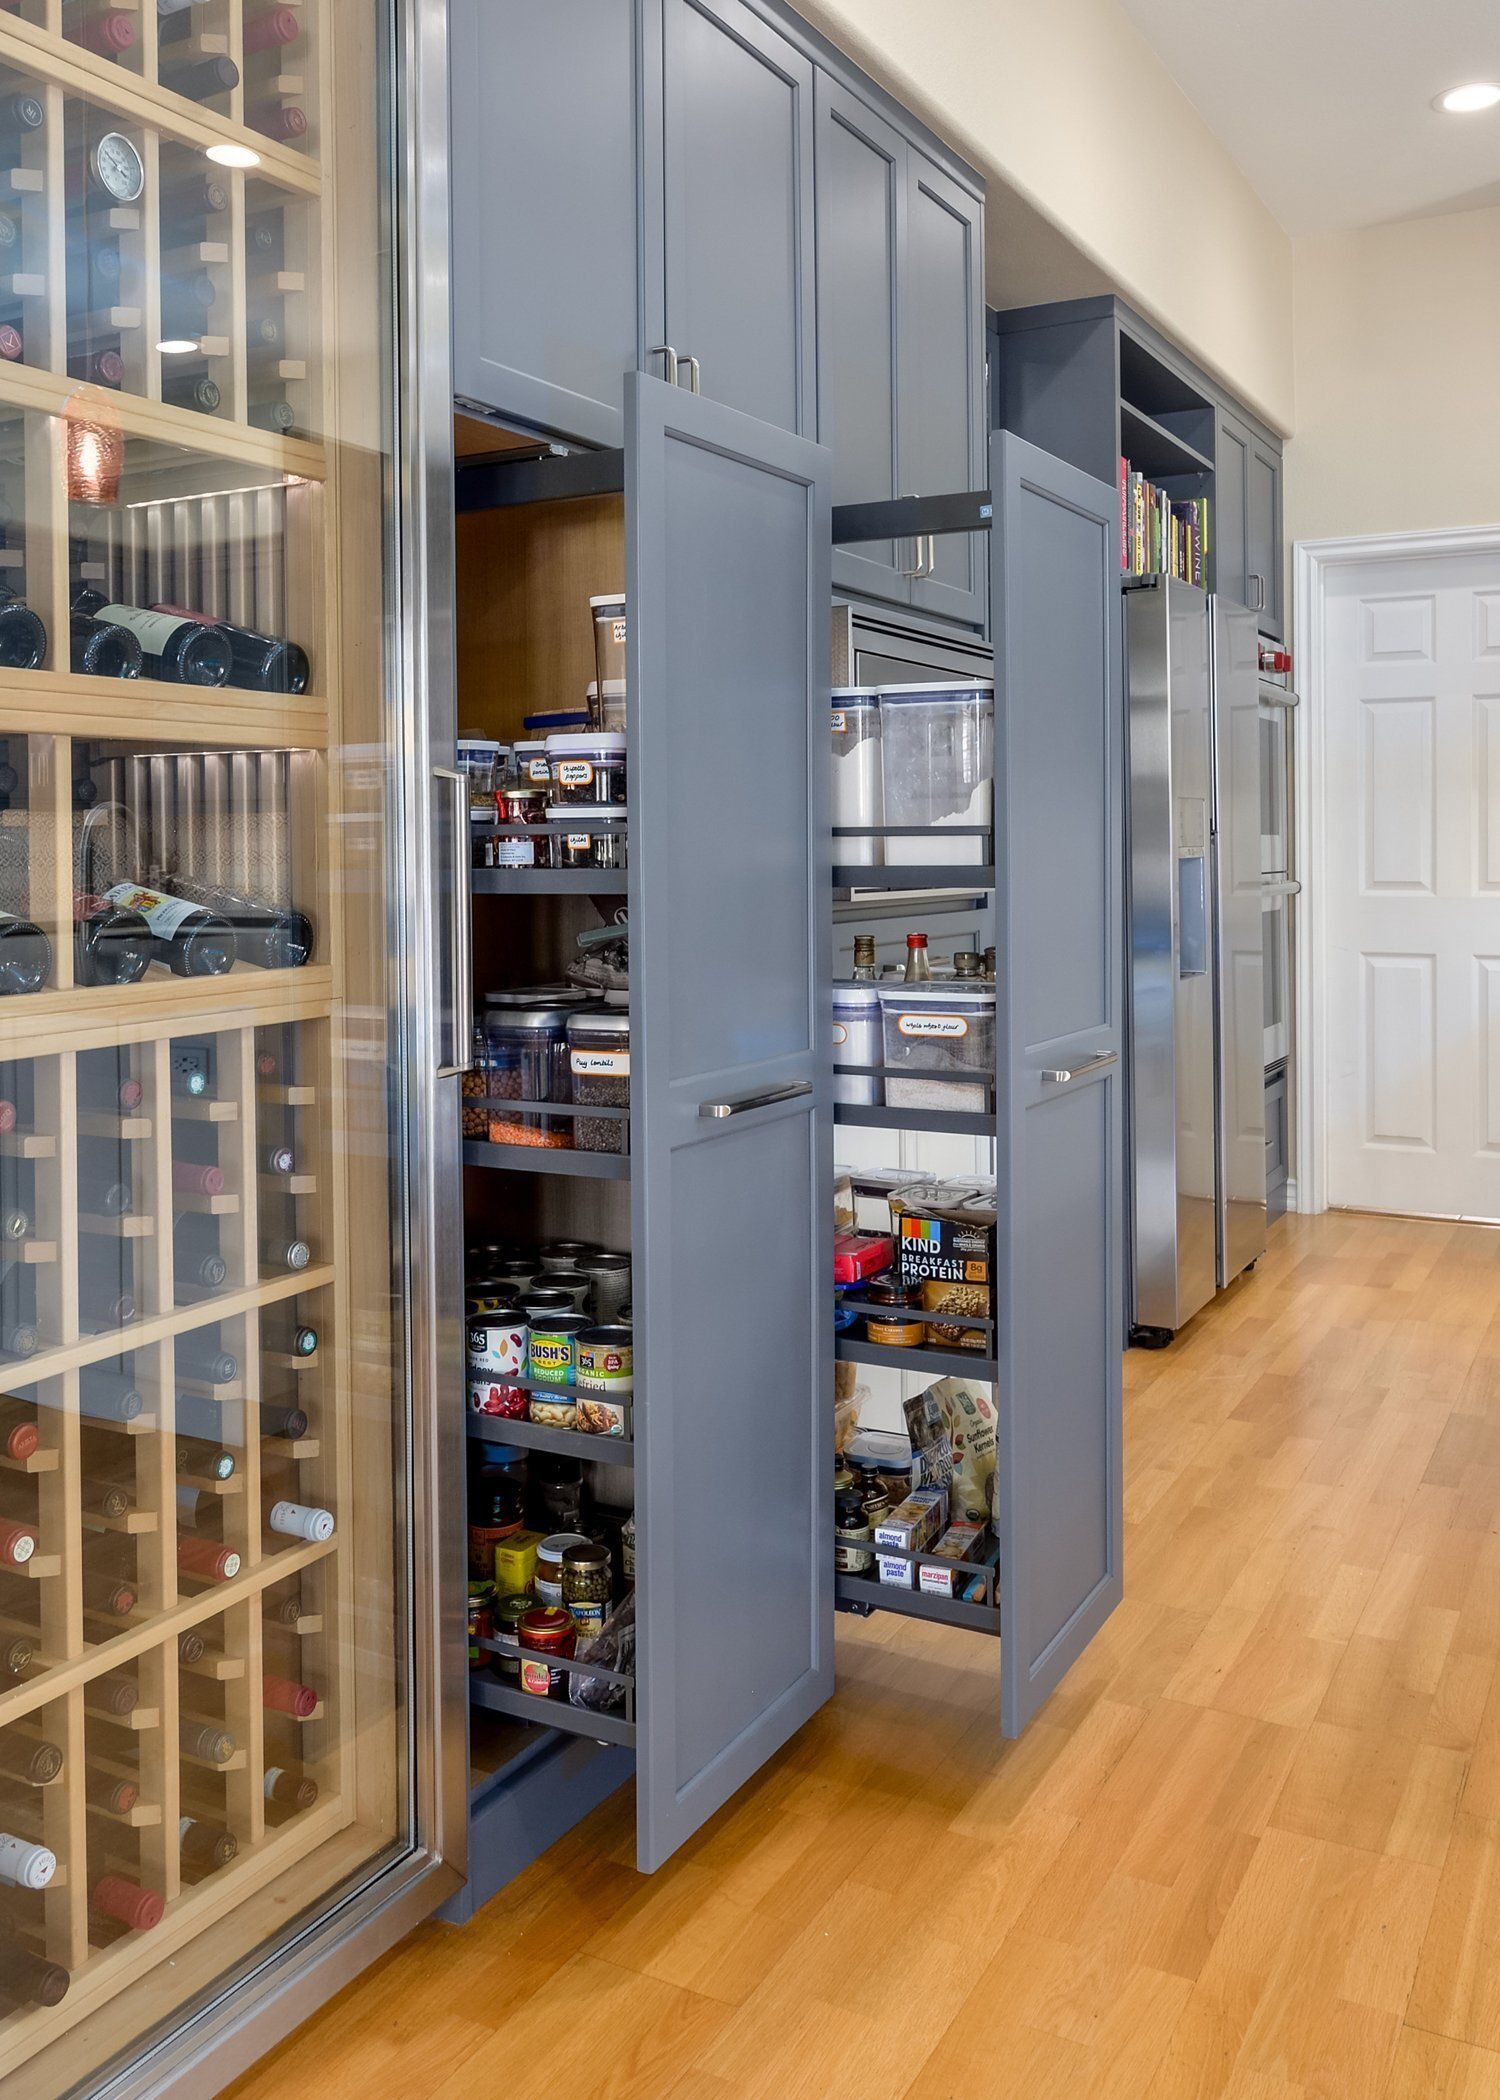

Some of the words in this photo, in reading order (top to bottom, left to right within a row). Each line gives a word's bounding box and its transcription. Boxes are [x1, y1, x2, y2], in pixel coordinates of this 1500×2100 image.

[901, 1235, 941, 1255] KIND
[901, 1253, 965, 1269] BREAKFAST
[901, 1261, 964, 1281] PROTEIN
[970, 1262, 983, 1273] 8g
[530, 1343, 570, 1362] BUSH'S
[533, 1367, 565, 1377] REDUCED
[535, 1373, 563, 1383] SODIUM
[966, 1425, 994, 1444] Sunflower
[973, 1436, 995, 1454] Kernels
[878, 1531, 902, 1543] almond
[883, 1560, 907, 1571] almond
[886, 1568, 904, 1578] paste
[921, 1570, 949, 1581] marzipan
